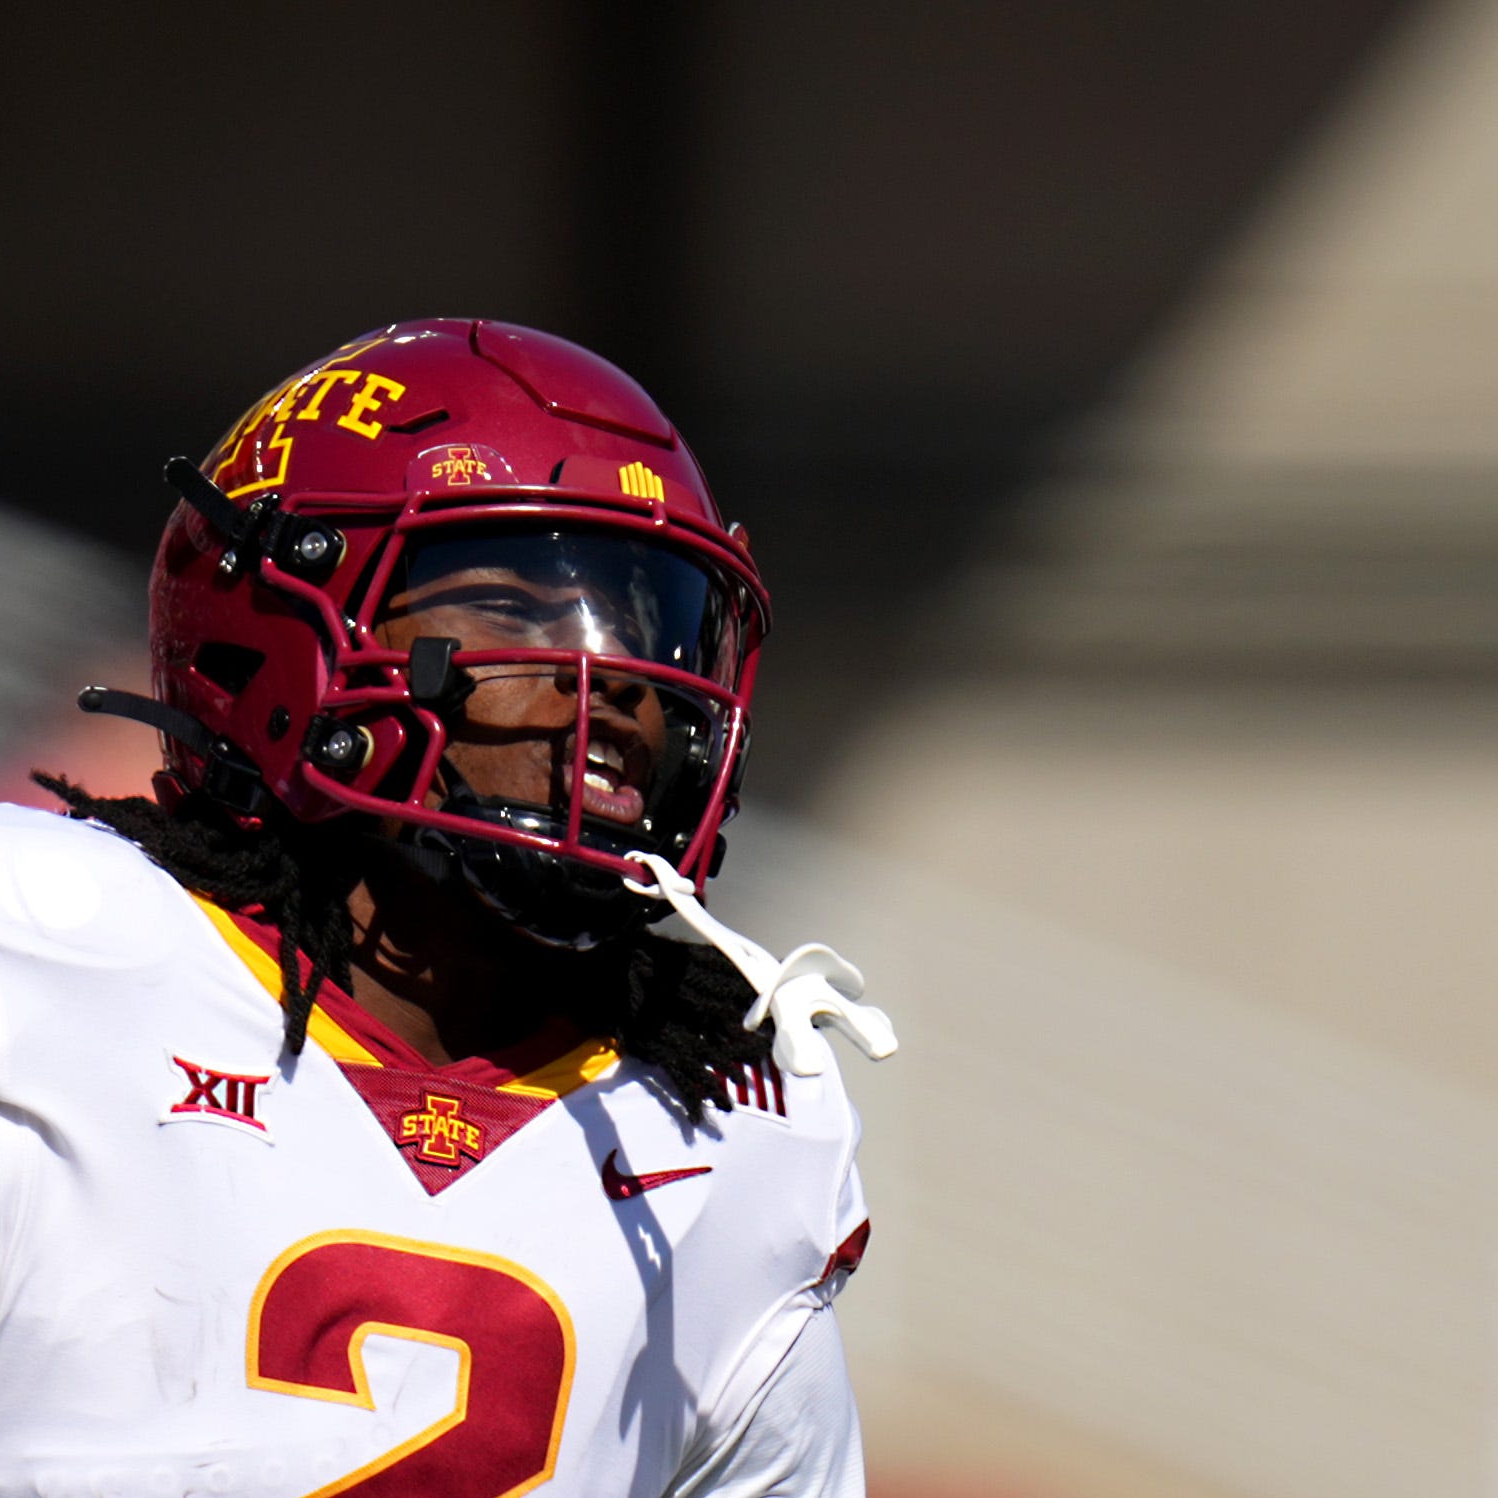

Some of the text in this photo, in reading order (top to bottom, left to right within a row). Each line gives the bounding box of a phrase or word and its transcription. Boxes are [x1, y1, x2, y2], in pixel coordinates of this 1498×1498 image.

[432, 459, 488, 479] STATE
[170, 1055, 271, 1132] XII
[403, 1114, 480, 1150] STATE
